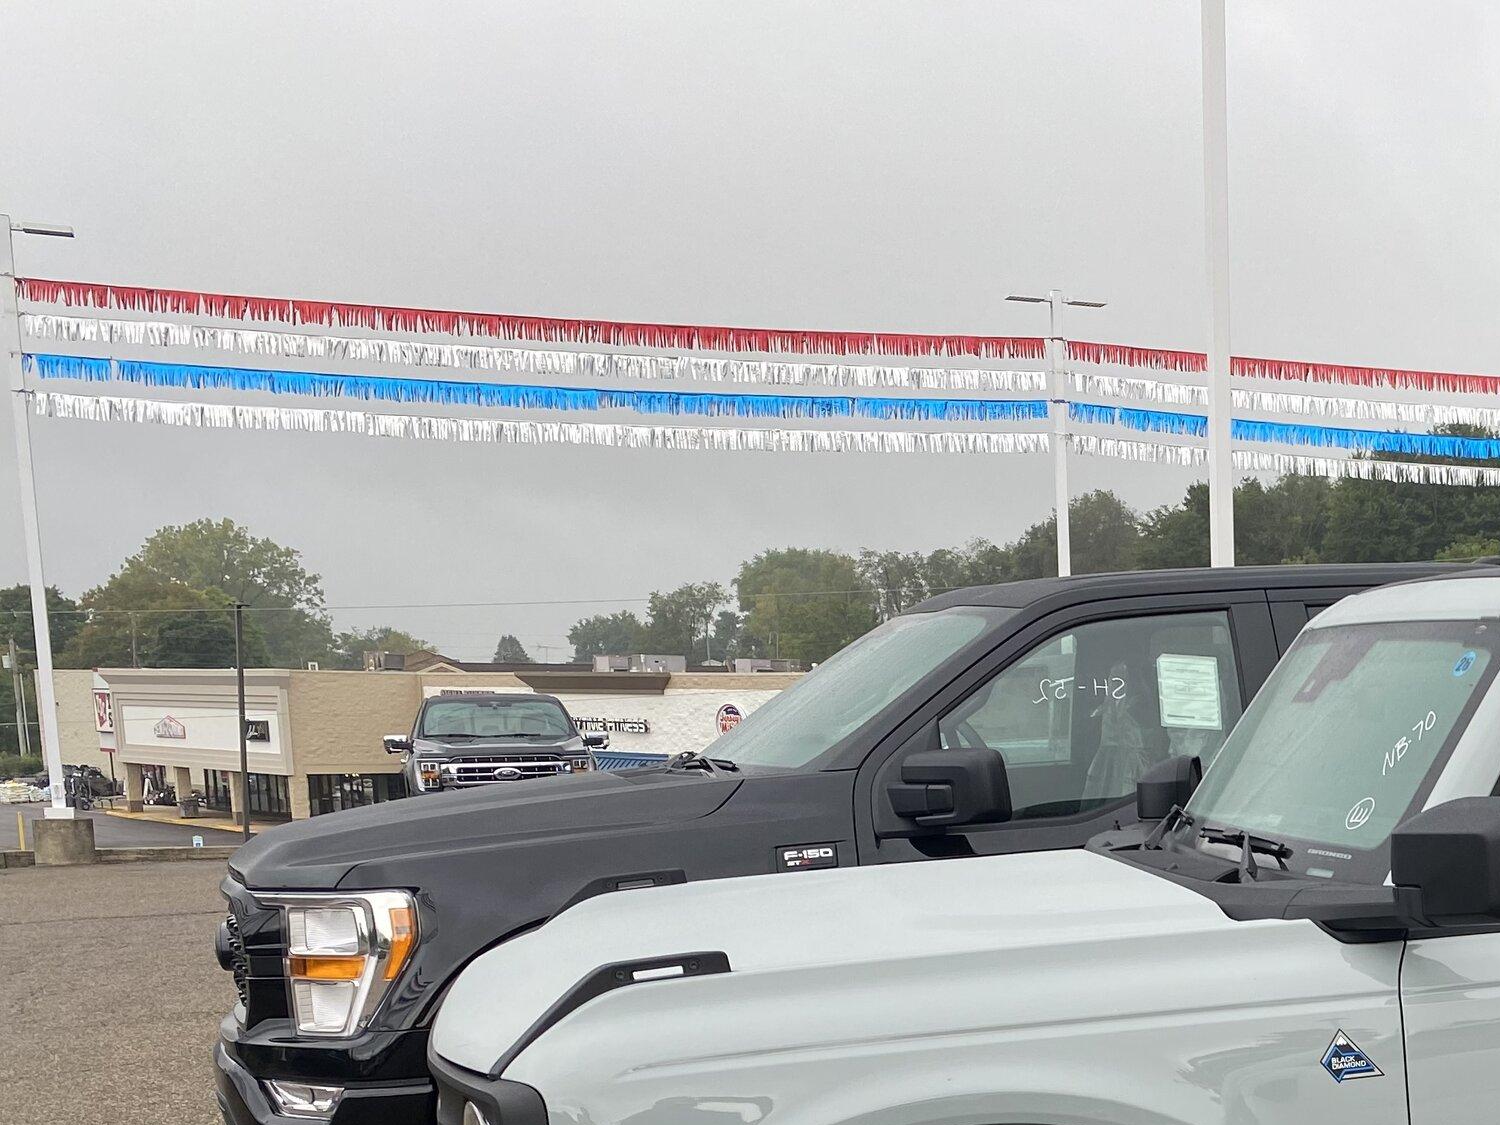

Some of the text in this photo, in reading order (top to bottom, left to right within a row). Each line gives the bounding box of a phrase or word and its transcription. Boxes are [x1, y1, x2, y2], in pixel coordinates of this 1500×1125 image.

[606, 719, 645, 733] FITNESS
[783, 847, 833, 861] F-150
[1307, 848, 1352, 860] BRONCO
[1331, 1055, 1356, 1064] BLACK
[1331, 1060, 1367, 1070] DIAMOND
